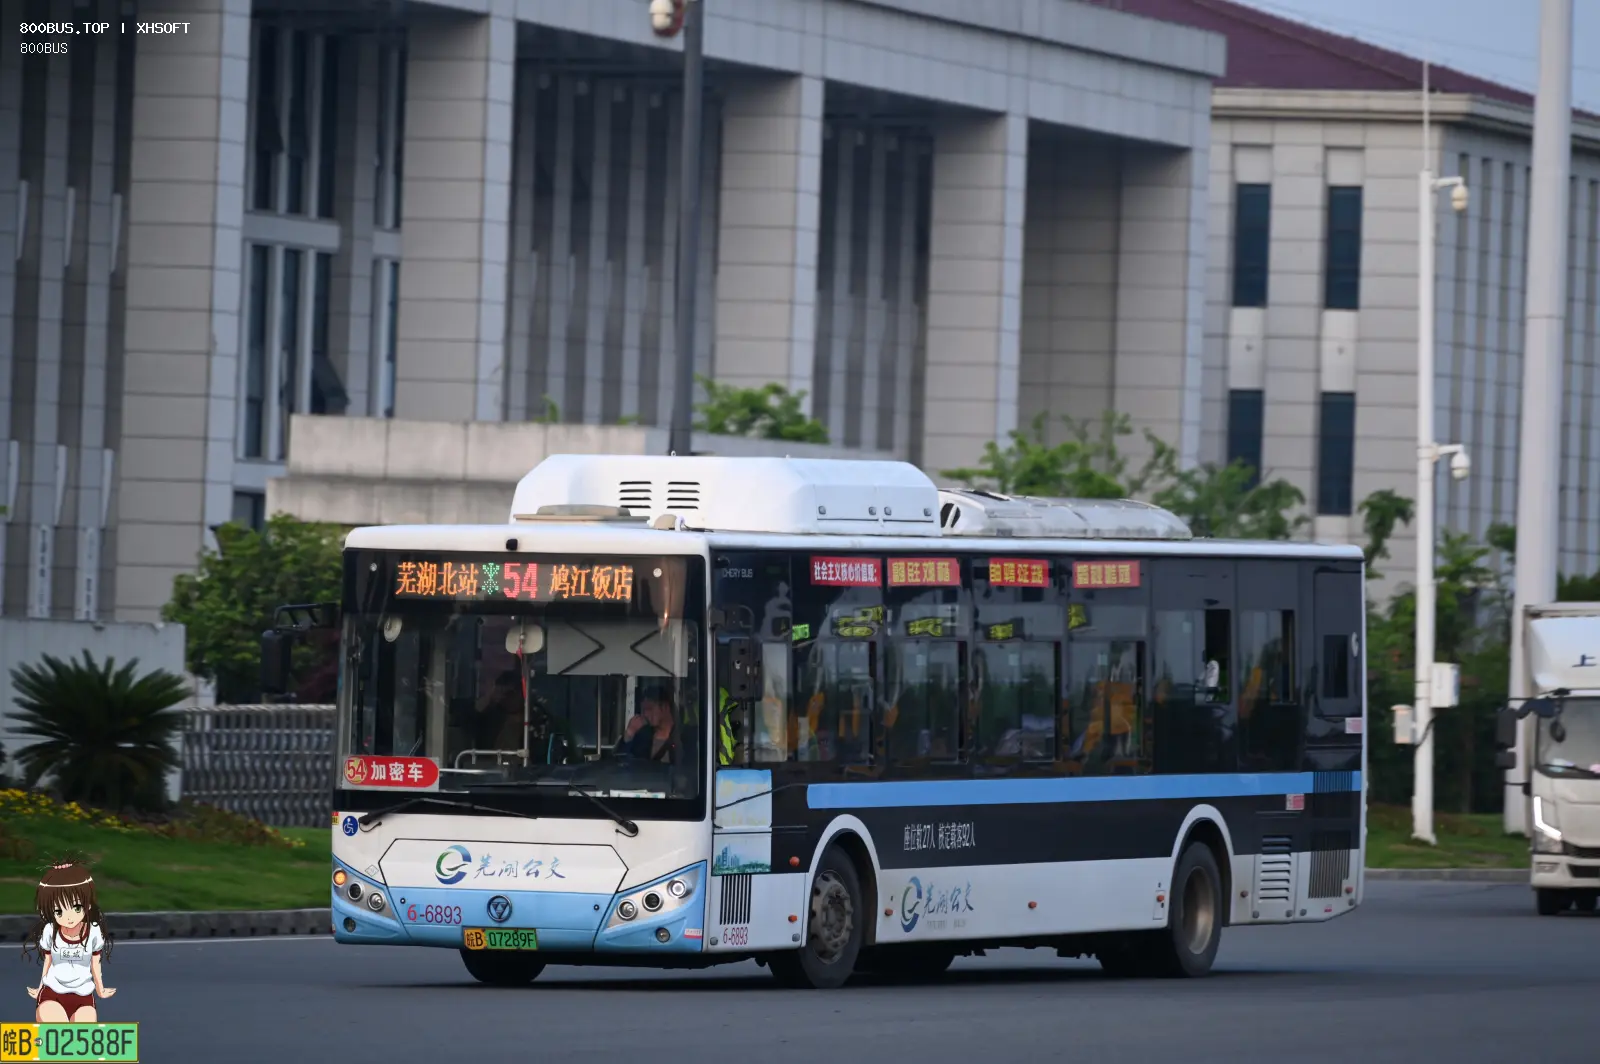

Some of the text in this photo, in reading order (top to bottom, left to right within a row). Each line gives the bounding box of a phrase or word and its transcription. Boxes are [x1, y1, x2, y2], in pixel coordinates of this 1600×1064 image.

[395, 561, 634, 600] 芜湖北站 54 鸠江饭店
[347, 759, 424, 782] 54 加密车
[473, 852, 566, 879] 芜湖公交
[407, 904, 462, 925] 6-6893
[488, 932, 534, 947] 07289F
[723, 927, 748, 946] 6-6893
